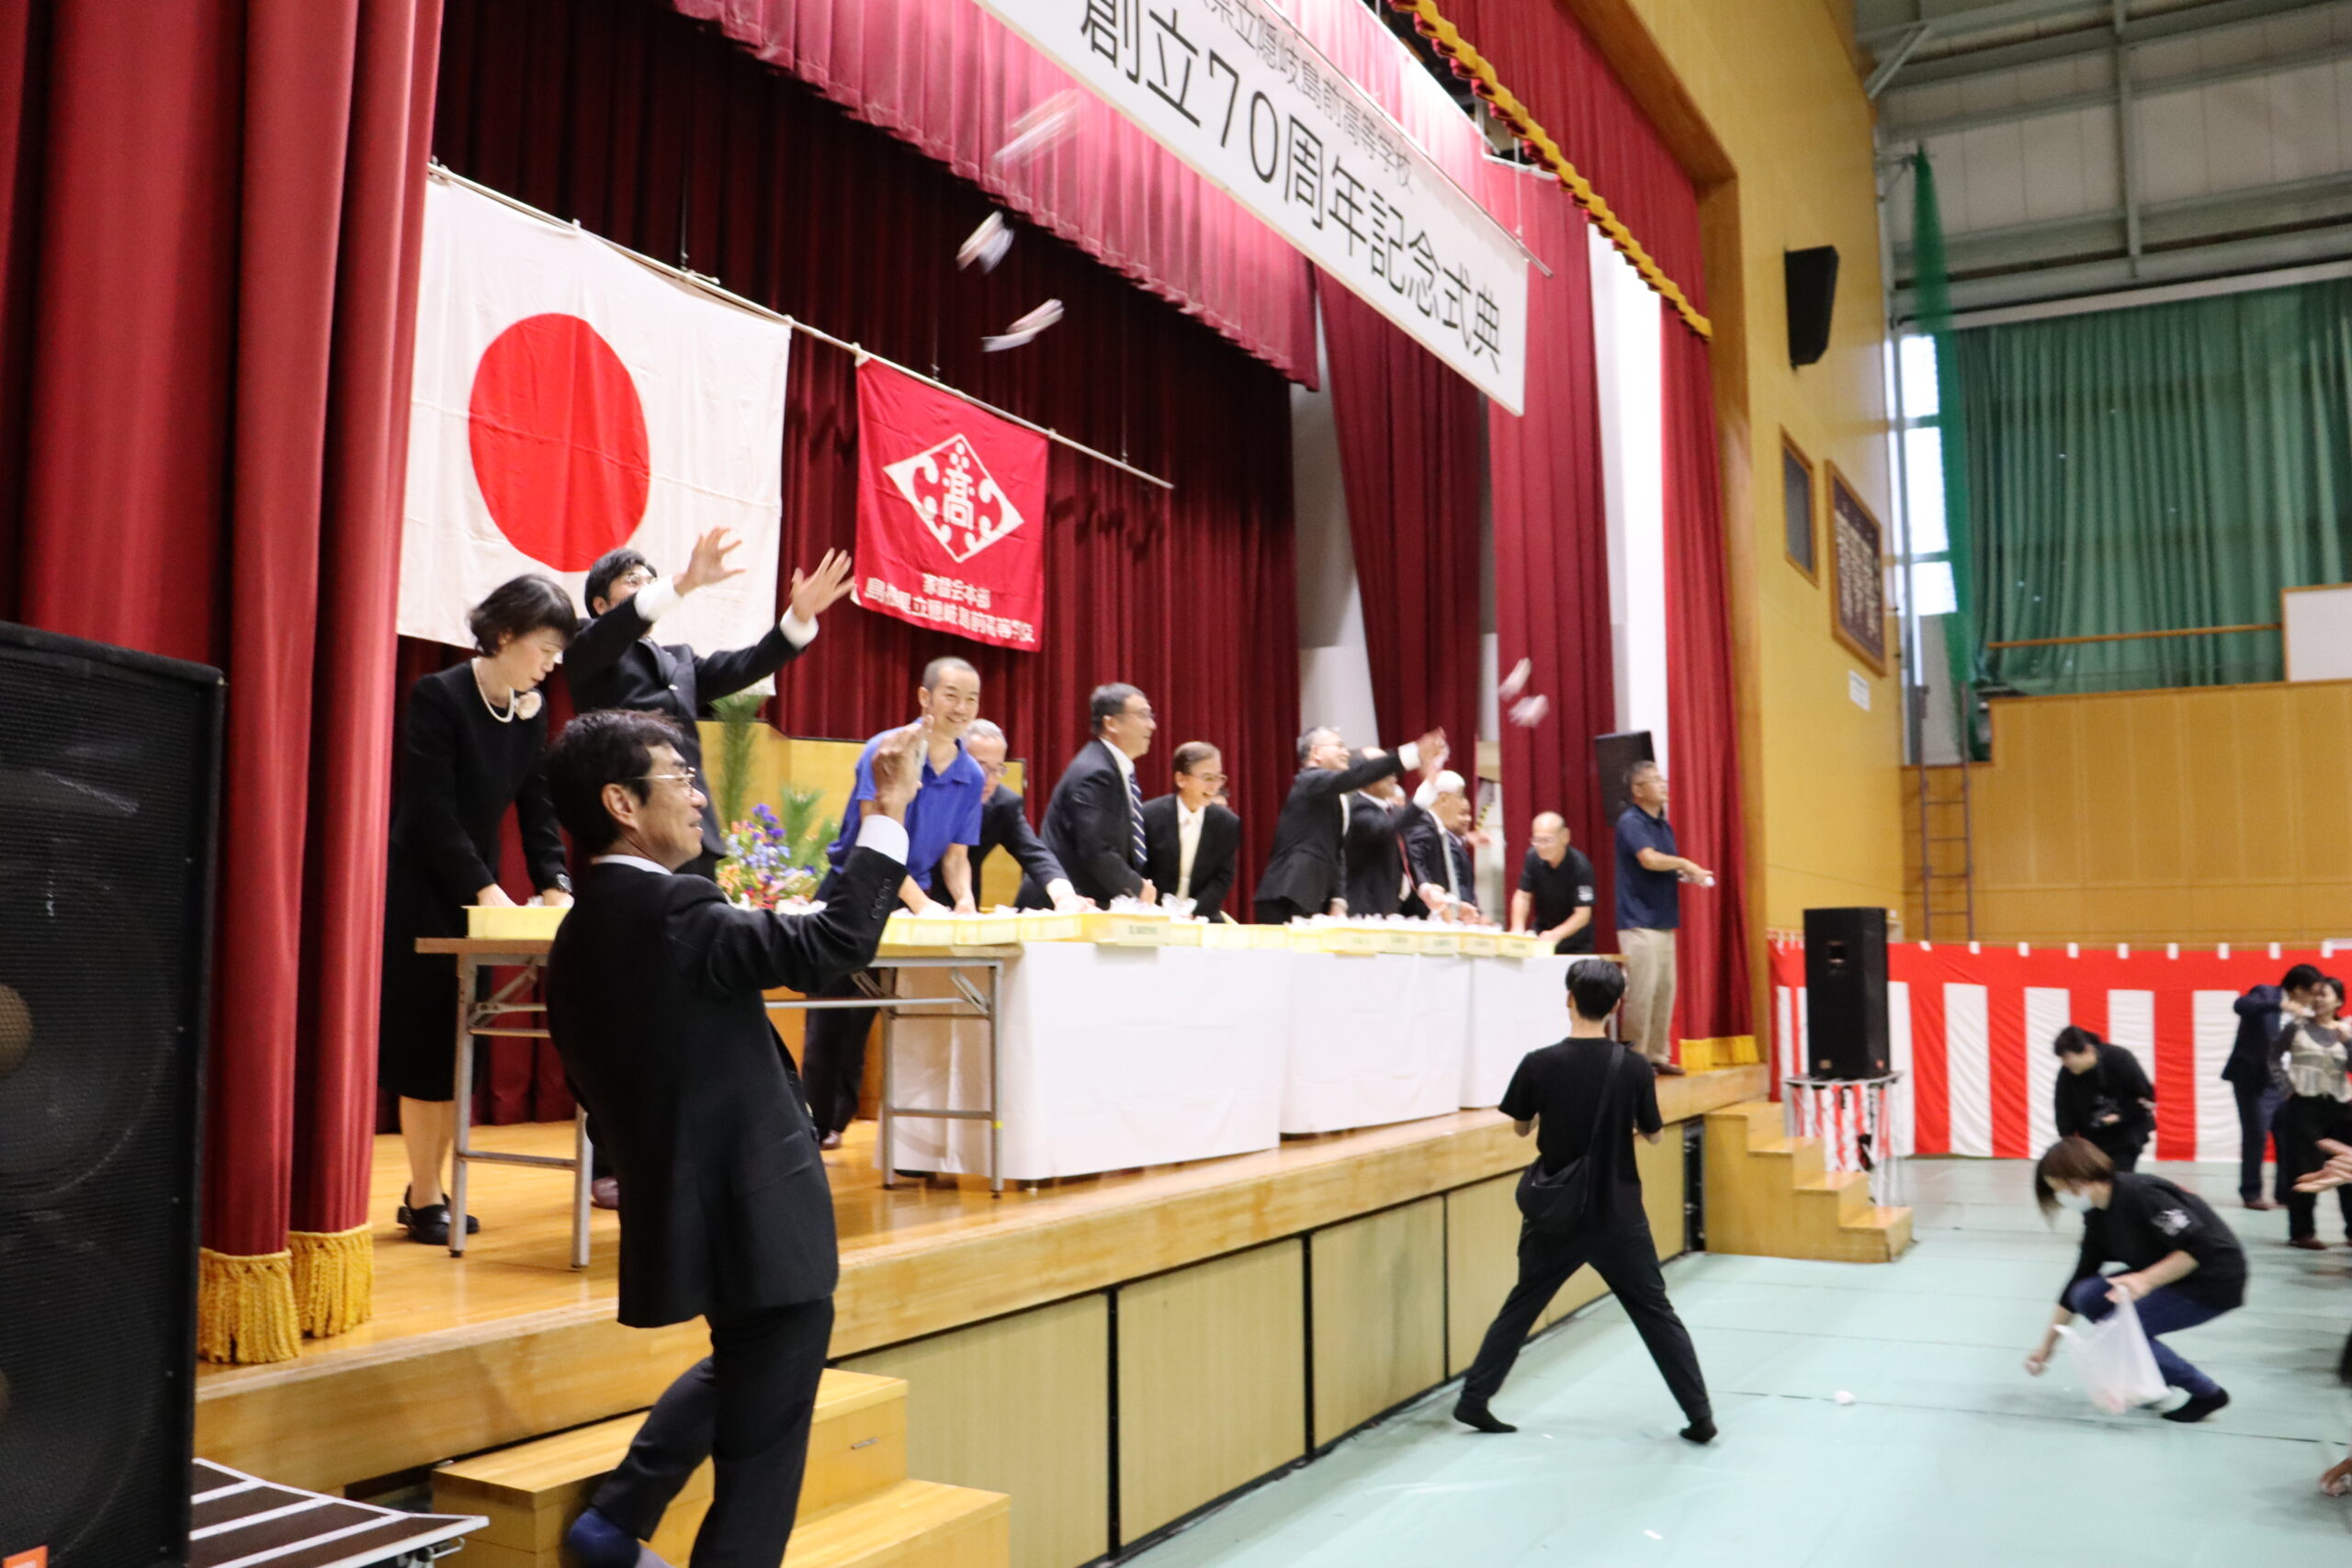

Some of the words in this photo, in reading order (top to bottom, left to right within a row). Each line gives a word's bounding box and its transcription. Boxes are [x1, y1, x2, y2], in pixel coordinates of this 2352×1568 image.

[1080, 0, 1501, 374] 創立70周年記念式典
